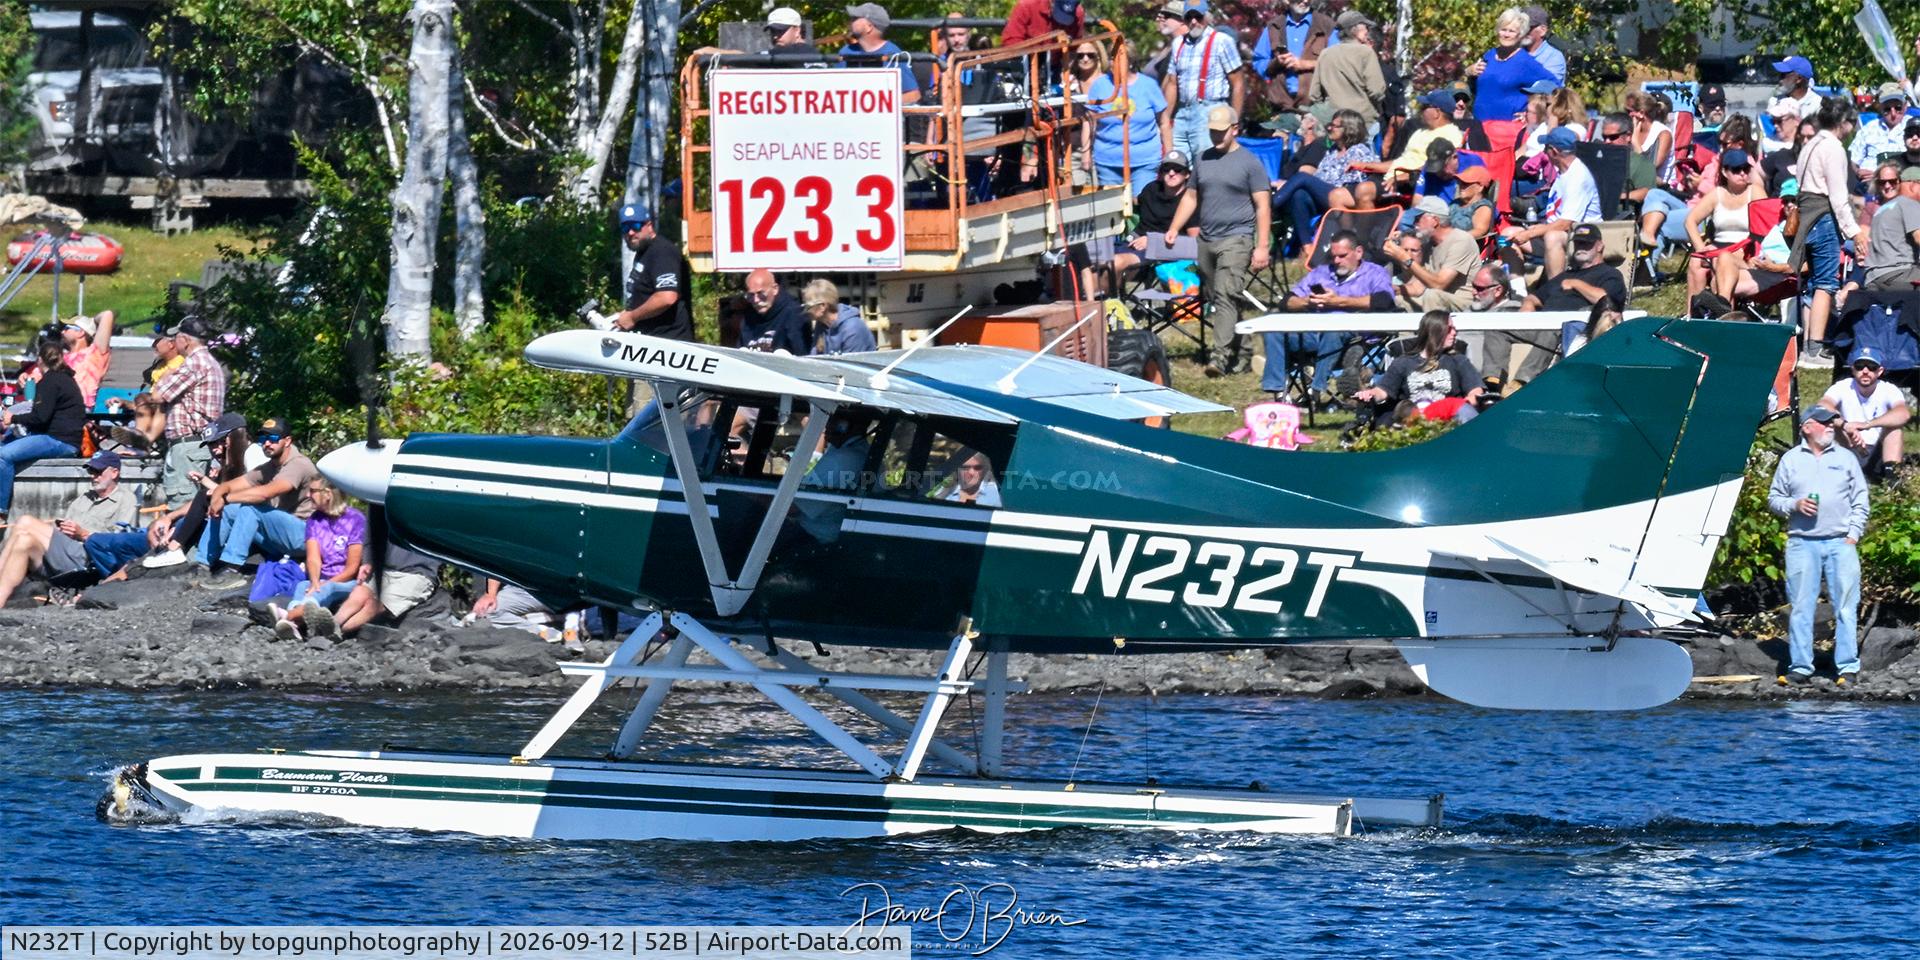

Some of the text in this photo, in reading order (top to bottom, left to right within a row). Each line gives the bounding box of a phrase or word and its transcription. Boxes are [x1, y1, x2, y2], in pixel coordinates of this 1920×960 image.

[718, 89, 894, 115] REGISTRATION
[732, 141, 882, 161] SEAPLANE BASE
[718, 174, 897, 254] 123.3
[620, 344, 720, 375] MAULE
[1071, 529, 1357, 618] N232T
[261, 768, 389, 783] Baumann Floats
[291, 785, 358, 796] BF 2750A
